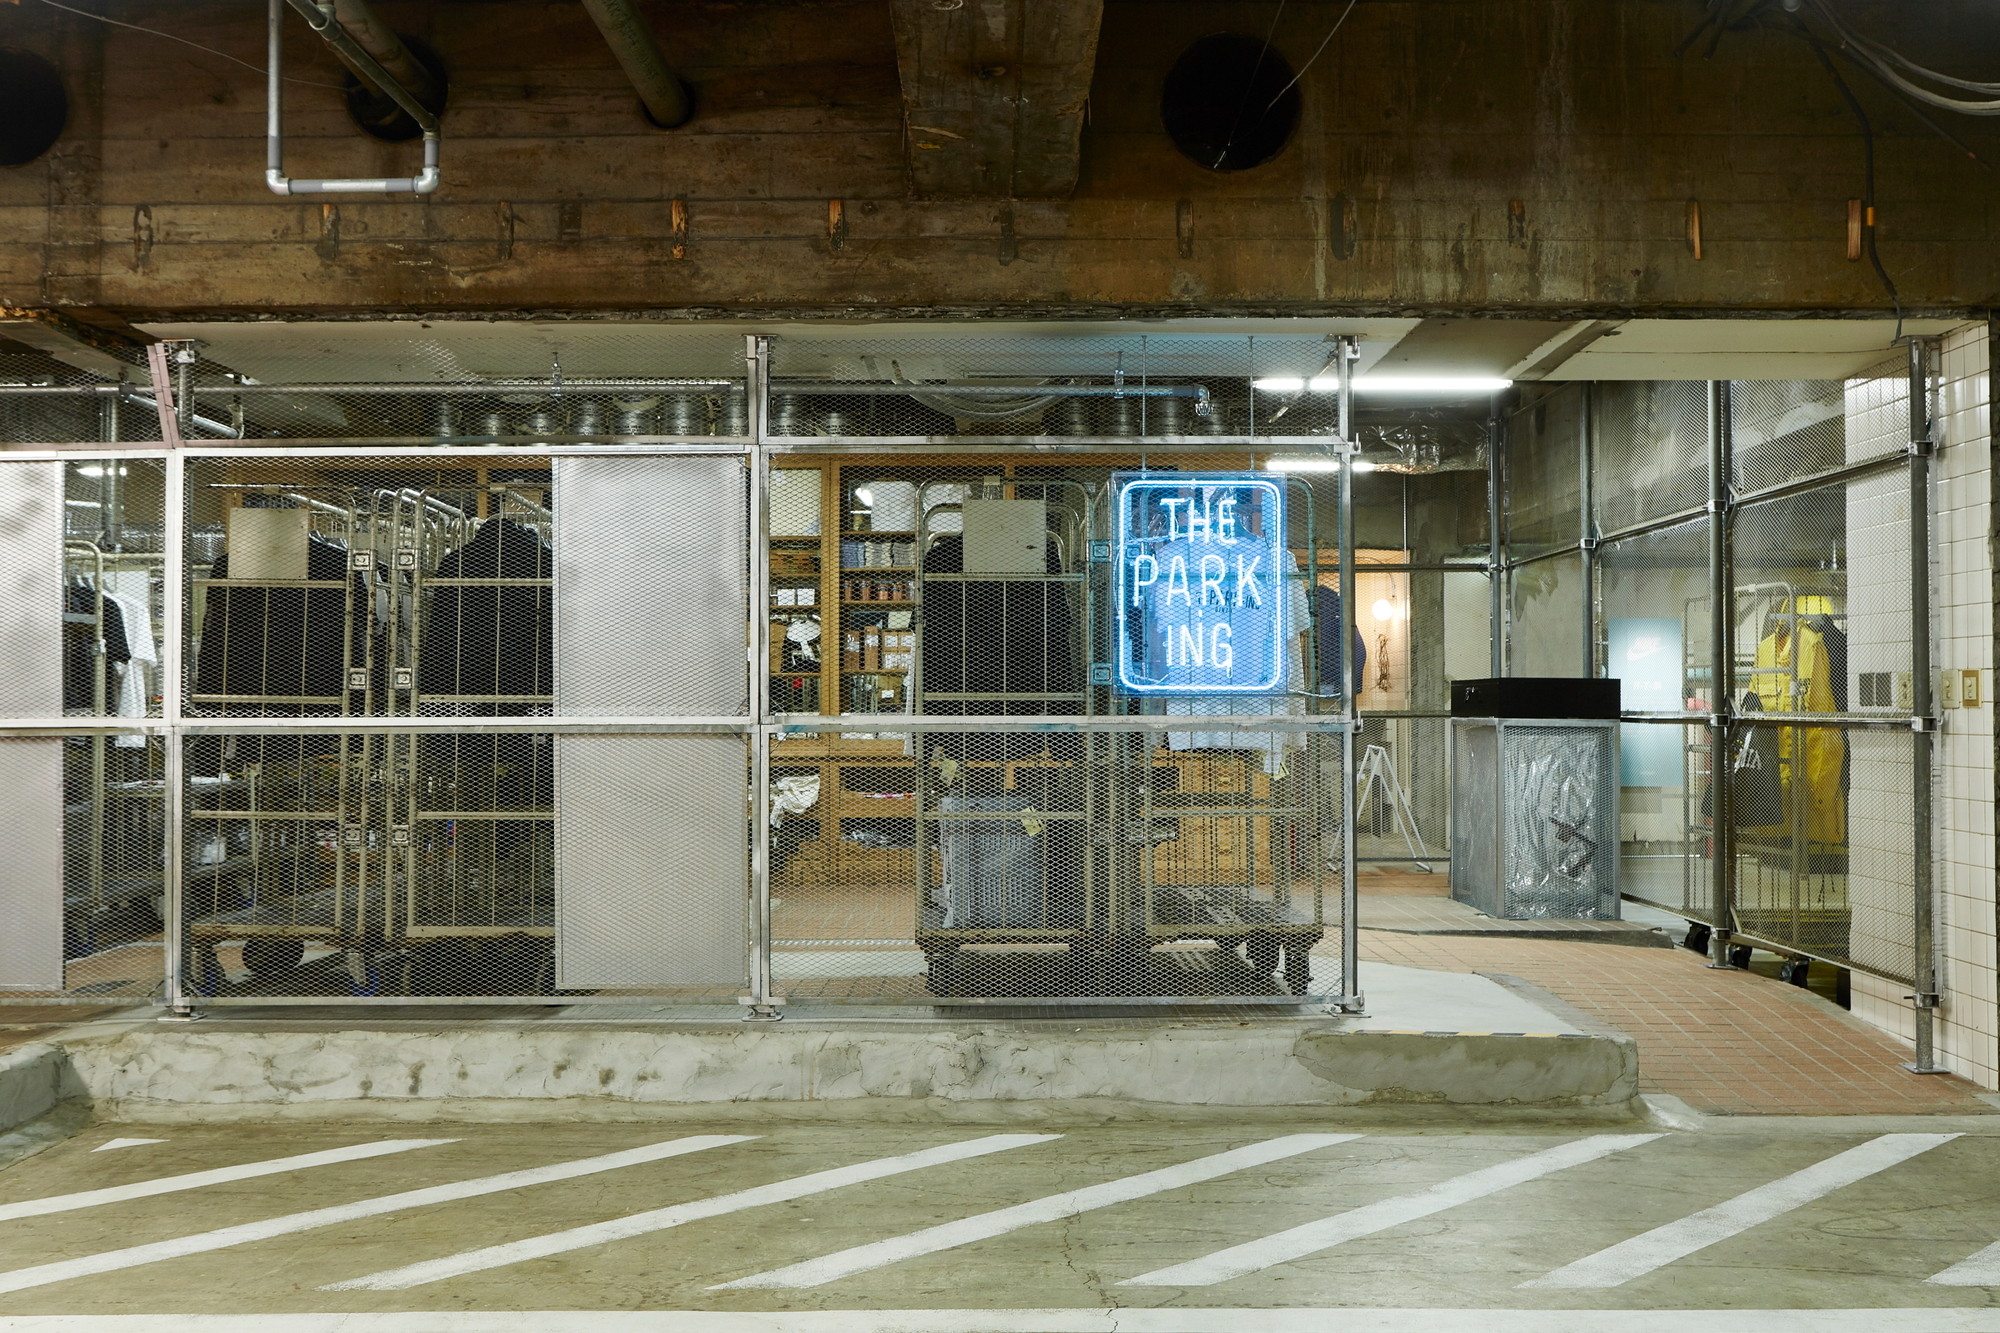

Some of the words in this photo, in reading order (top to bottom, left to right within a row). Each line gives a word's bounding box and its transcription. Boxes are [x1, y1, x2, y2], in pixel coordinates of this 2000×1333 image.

[1160, 498, 1237, 544] THE
[1133, 554, 1262, 607] PARK
[1166, 622, 1233, 670] ING
